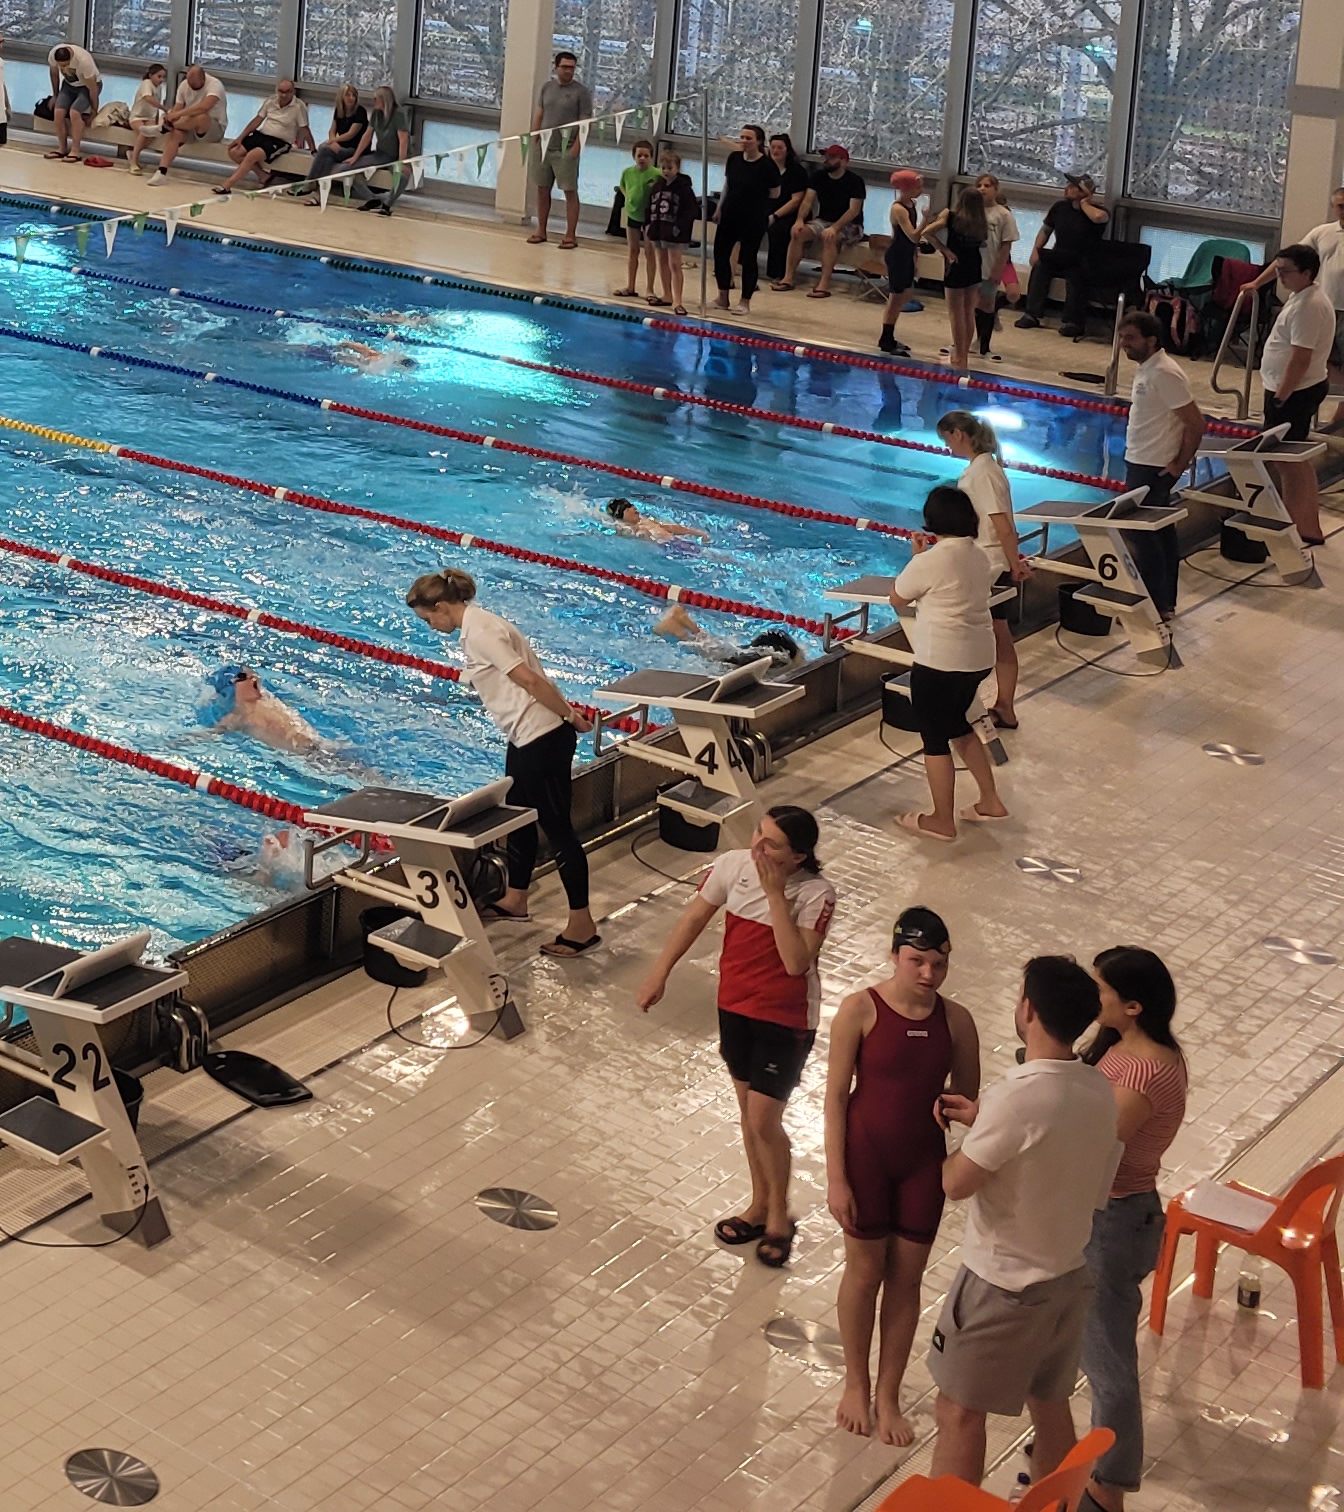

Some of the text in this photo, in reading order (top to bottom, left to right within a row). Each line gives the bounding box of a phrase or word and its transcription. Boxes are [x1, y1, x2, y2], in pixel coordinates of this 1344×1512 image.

[1245, 483, 1264, 508] 7
[1098, 553, 1118, 580] 6
[695, 741, 719, 775] 4
[726, 738, 743, 772] 4
[416, 870, 439, 909] 3
[446, 870, 467, 909] 3
[52, 1043, 76, 1092] 2
[82, 1042, 111, 1092] 2
